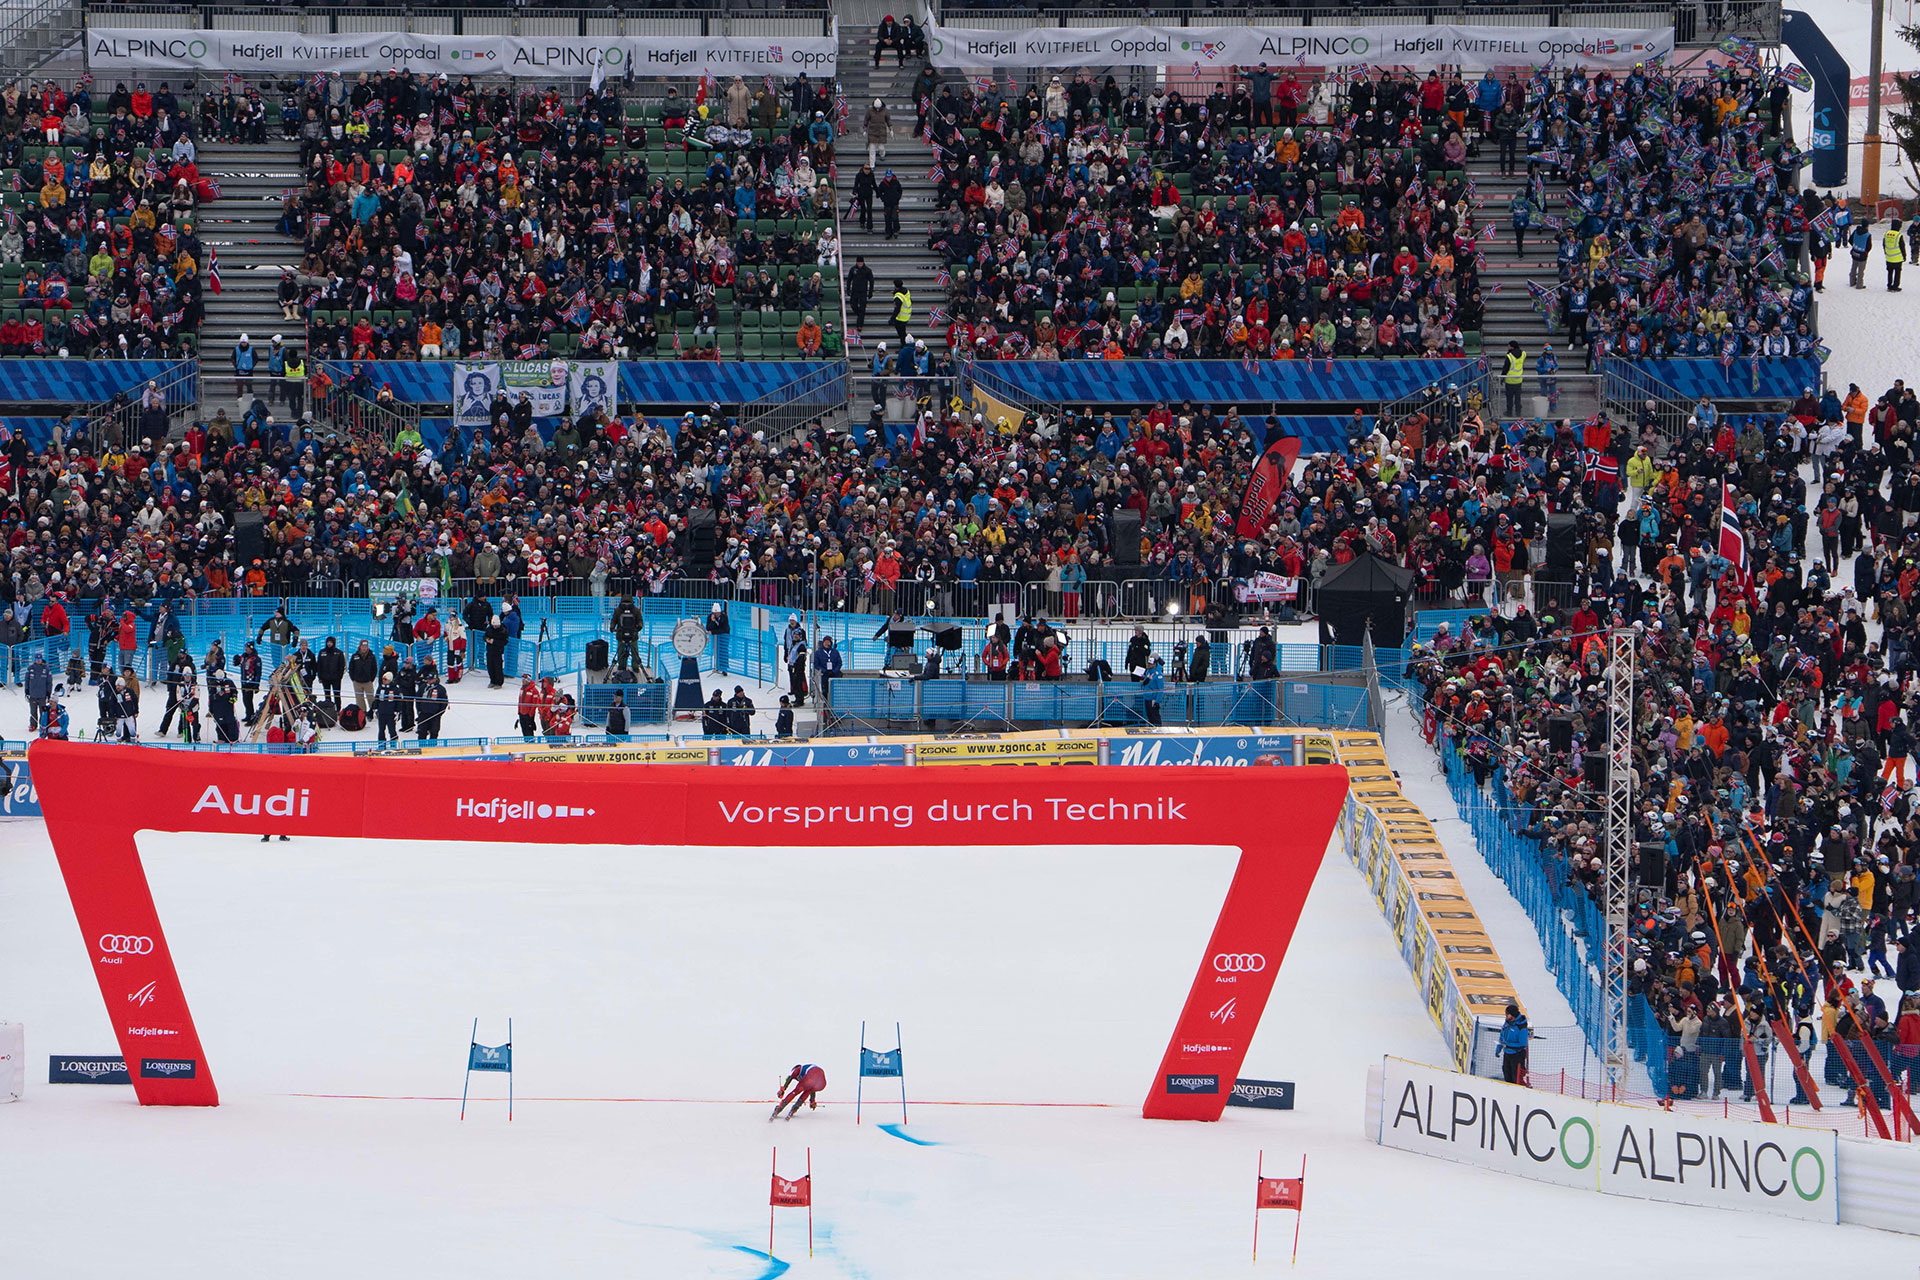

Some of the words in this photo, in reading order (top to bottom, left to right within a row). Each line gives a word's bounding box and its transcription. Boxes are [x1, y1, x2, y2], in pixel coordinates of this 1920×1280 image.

[95, 39, 207, 58] ALPINCO
[232, 44, 283, 61] Hafjell
[292, 45, 369, 60] KVITFJELL
[379, 44, 440, 64] Oppdal
[968, 41, 1016, 58] Hafjell
[1026, 40, 1101, 54] KVITFJELL
[1111, 36, 1171, 58] Oppdal
[1259, 36, 1369, 55] ALPINCO
[1394, 38, 1443, 55] Hafjell
[1453, 39, 1528, 53] KVITFJELL
[513, 47, 623, 66] ALPINCO
[648, 50, 697, 68] Hafjell
[1813, 133, 1831, 147] 5G
[513, 362, 549, 373] LUCAS
[538, 392, 560, 400] LUCAS
[1241, 471, 1267, 516] Oppdal
[1249, 497, 1270, 528] Alpin
[1265, 573, 1285, 583] TIMON
[380, 580, 418, 592] LUCAS
[920, 746, 957, 754] ZGONC
[967, 742, 1047, 753] www.zgonc.at
[1056, 742, 1094, 750] ZGONC
[576, 750, 657, 763] www.zgonc.at
[666, 751, 705, 759] ZGONC
[191, 784, 310, 817] Audi
[456, 797, 534, 823] Hafjell
[718, 800, 914, 828] Vorsprung
[927, 799, 1033, 822] durch
[1044, 796, 1187, 821] Technik
[100, 956, 123, 965] Audi
[1215, 975, 1237, 983] Audi
[128, 1027, 157, 1037] Hafjell
[1183, 1044, 1211, 1054] Hafjell
[60, 1061, 128, 1072] LONGINES
[145, 1062, 192, 1071] LONGINES
[1171, 1077, 1215, 1086] LONGINES
[1230, 1084, 1284, 1097] ONGINES
[1393, 1079, 1595, 1170] ALPINCO
[1612, 1124, 1825, 1202] ALPINCO
